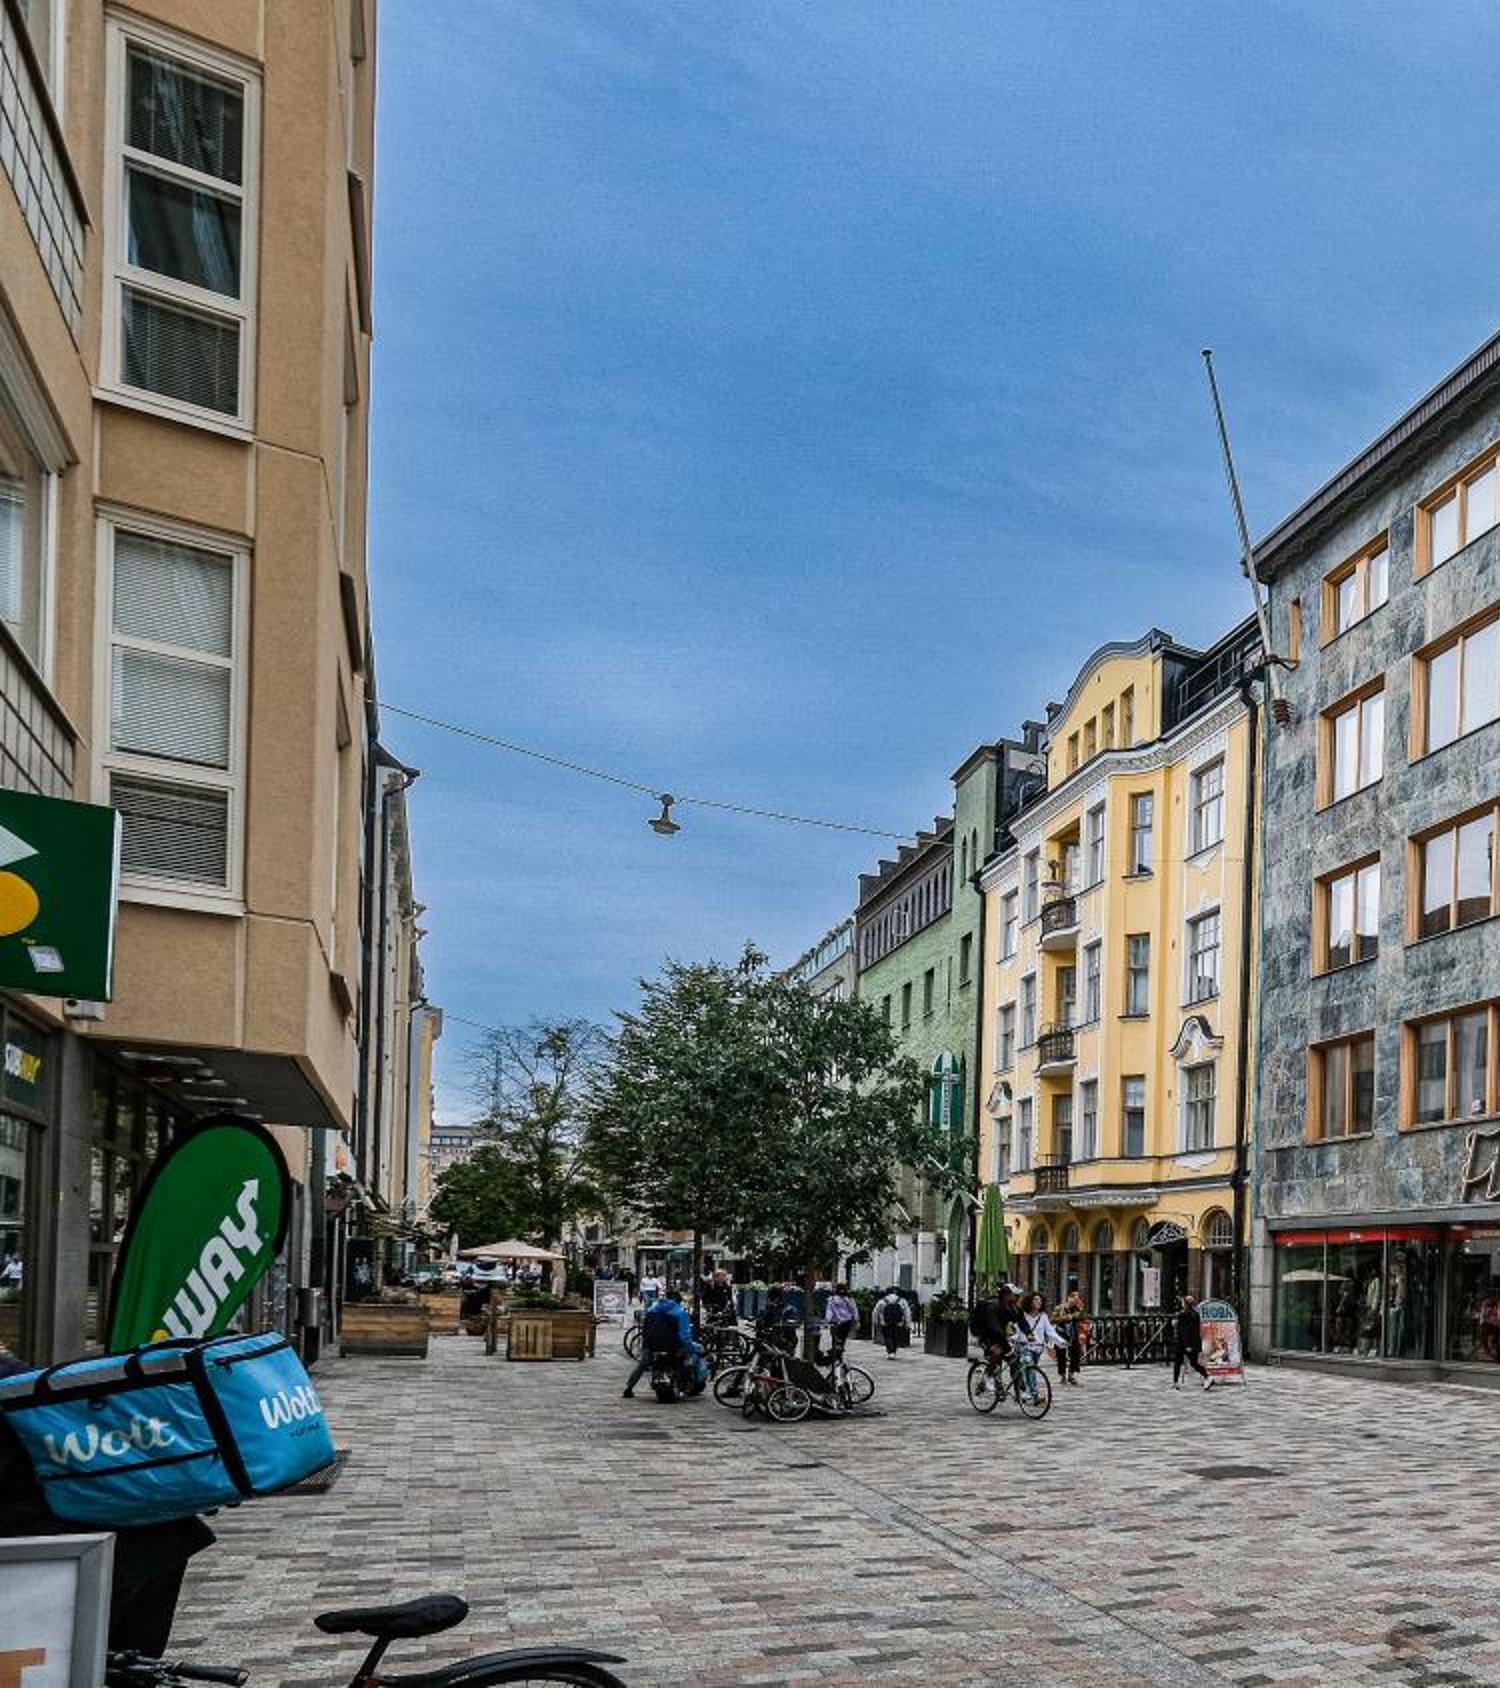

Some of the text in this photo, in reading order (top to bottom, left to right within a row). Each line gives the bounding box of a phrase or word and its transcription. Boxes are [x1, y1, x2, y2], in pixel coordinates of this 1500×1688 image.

[152, 1178, 263, 1341] WAY
[260, 1385, 321, 1429] Wolt
[45, 1416, 175, 1465] Wolt
